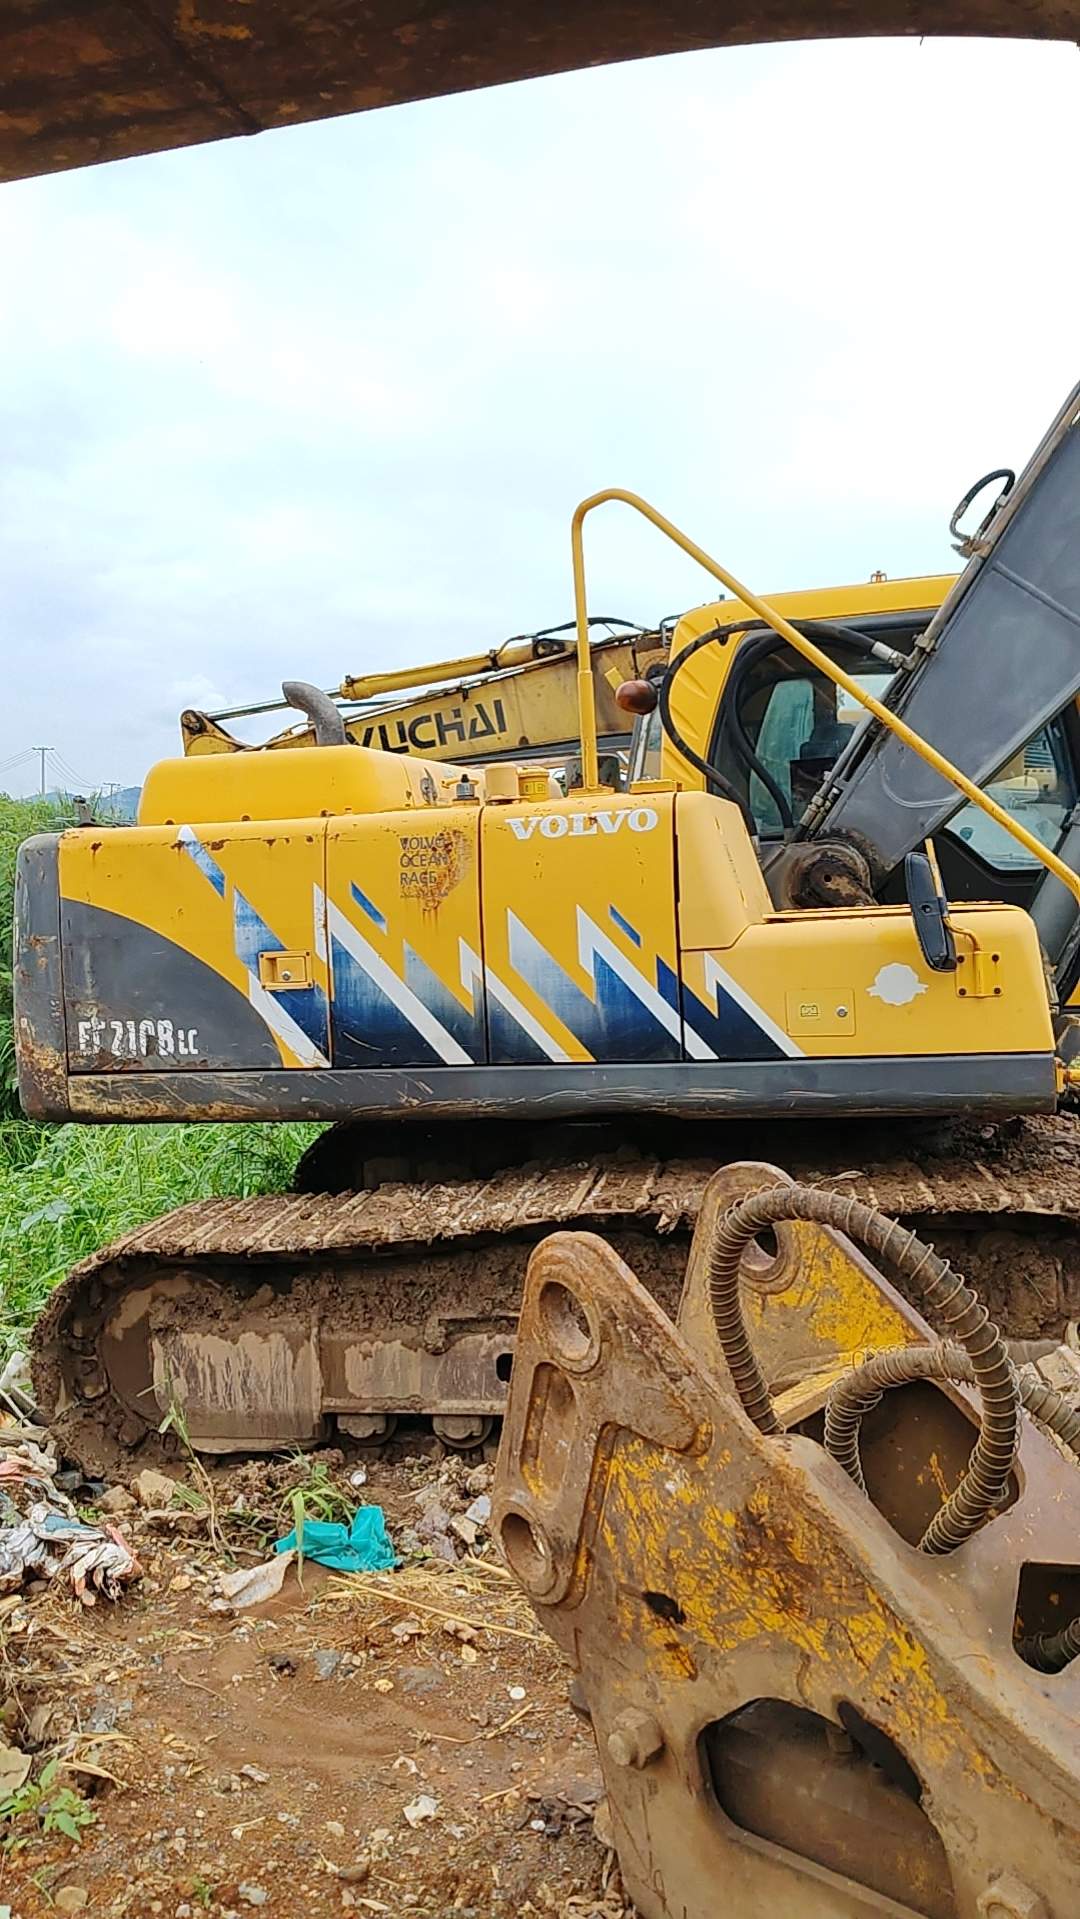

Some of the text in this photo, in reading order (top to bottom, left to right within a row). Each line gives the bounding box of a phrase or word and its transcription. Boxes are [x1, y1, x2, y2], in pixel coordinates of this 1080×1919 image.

[345, 699, 507, 755] YUCHAI
[505, 808, 659, 840] VOLVO
[400, 835, 446, 850] VOLVO
[400, 853, 448, 868] OCEAN
